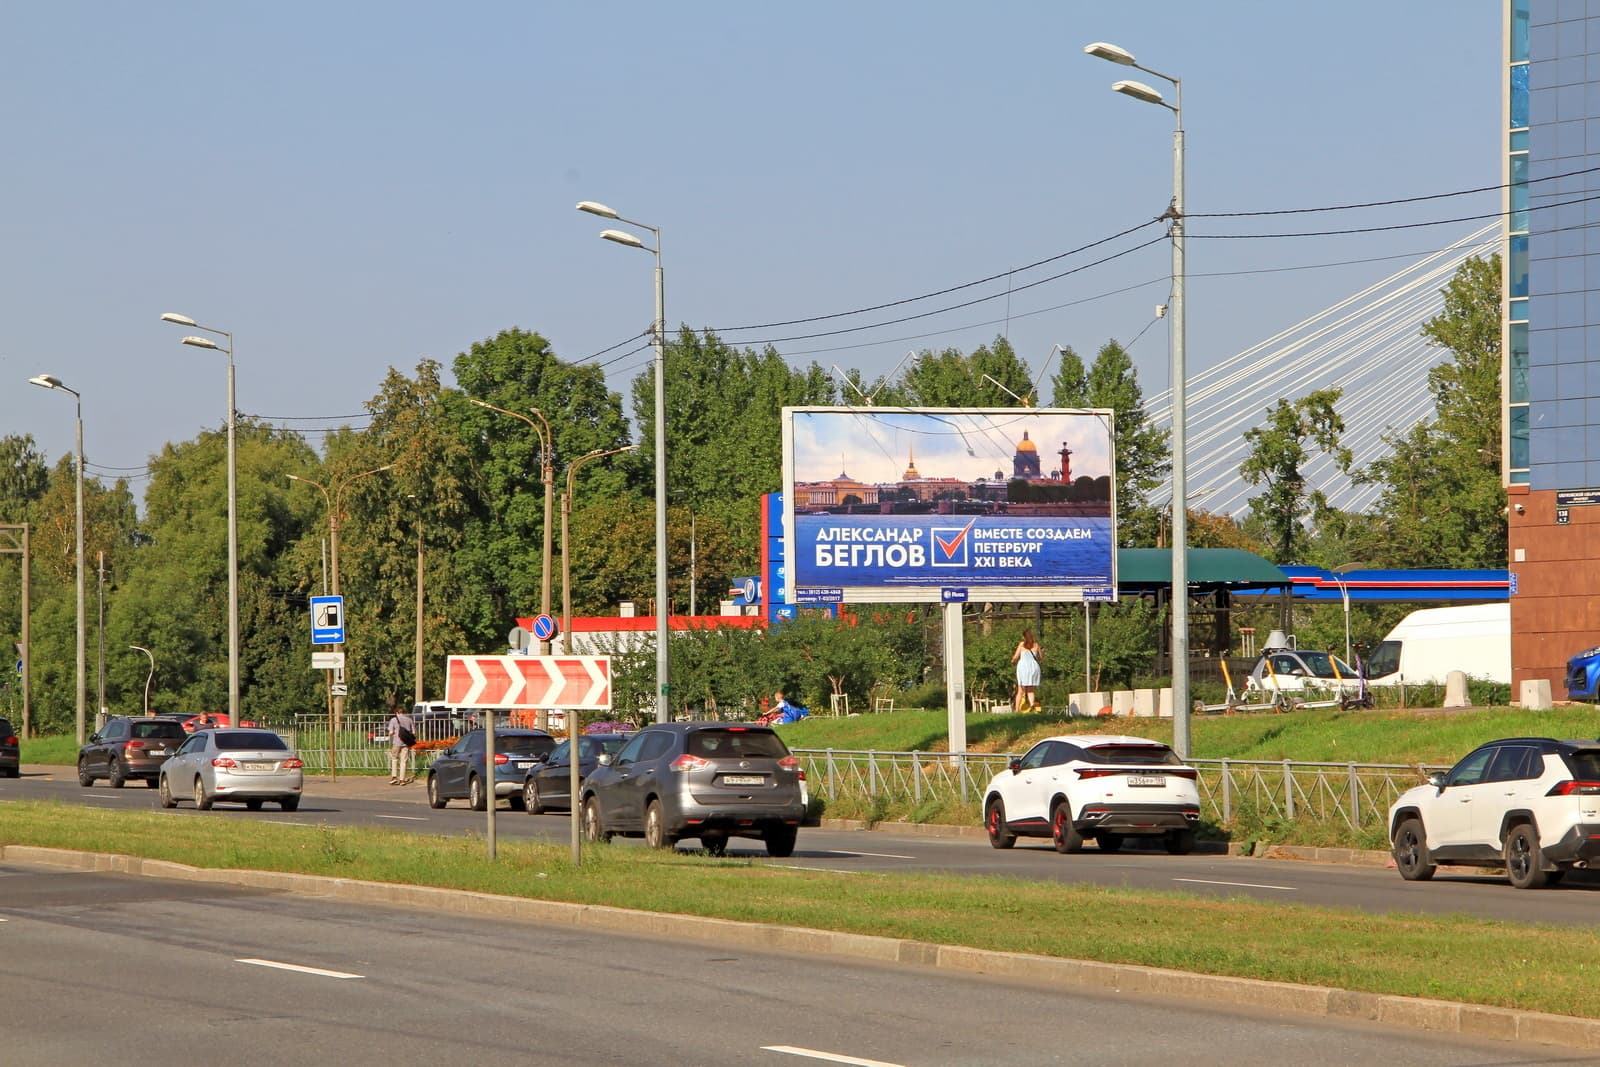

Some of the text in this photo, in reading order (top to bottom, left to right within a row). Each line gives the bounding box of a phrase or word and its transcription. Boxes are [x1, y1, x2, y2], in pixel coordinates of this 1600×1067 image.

[816, 528, 923, 543] АЛЕКСАНДР
[974, 528, 1091, 540] ВМЕСТЕ СОЗДАЕМ
[974, 543, 1043, 553] ПЕТЕРБУРГ
[815, 544, 926, 567] БЕГЛОВ
[999, 557, 1032, 567] ВЕКА
